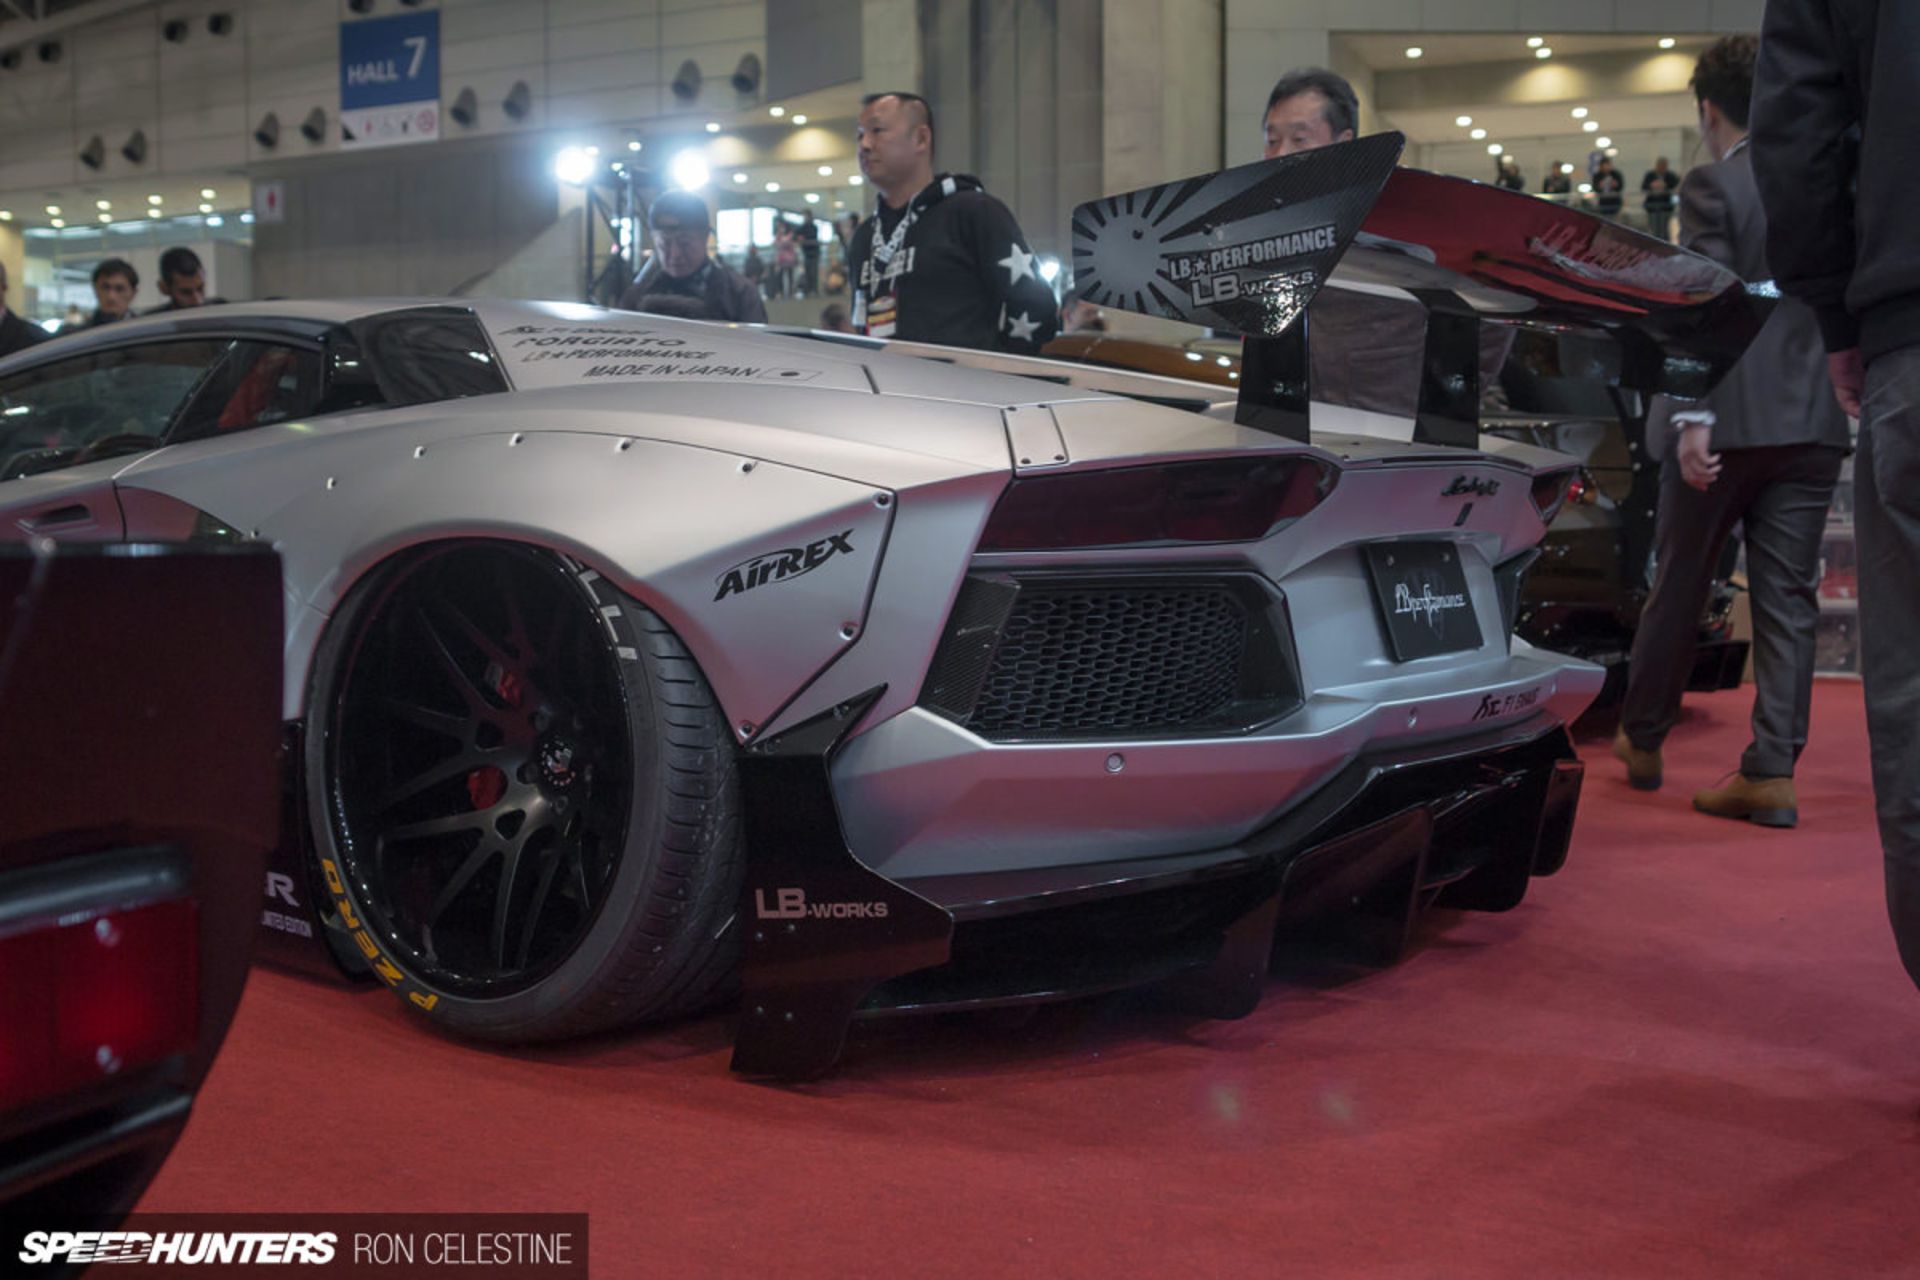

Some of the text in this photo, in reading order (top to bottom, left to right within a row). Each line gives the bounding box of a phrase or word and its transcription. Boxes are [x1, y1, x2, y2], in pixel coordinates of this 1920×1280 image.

[347, 36, 427, 87] HALL 7
[583, 364, 761, 378] MADE IN JAPAN
[265, 871, 299, 907] R
[321, 858, 439, 1011] P ZERO
